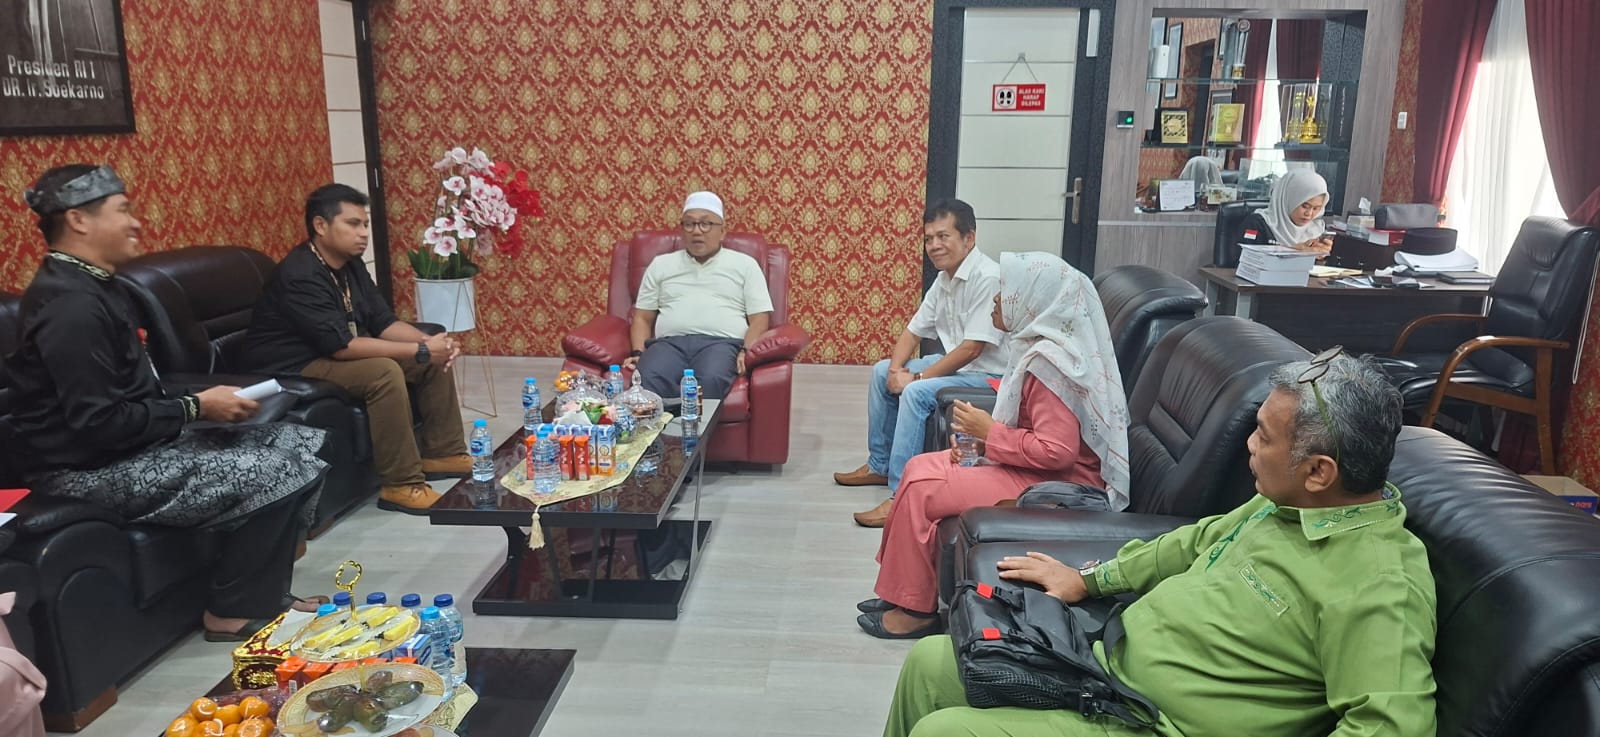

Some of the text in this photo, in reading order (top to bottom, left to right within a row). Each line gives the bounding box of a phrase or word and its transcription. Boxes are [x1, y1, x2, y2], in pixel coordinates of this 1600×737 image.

[7, 54, 71, 78] Presiden
[74, 59, 88, 79] RI
[43, 79, 105, 100] Soekarno
